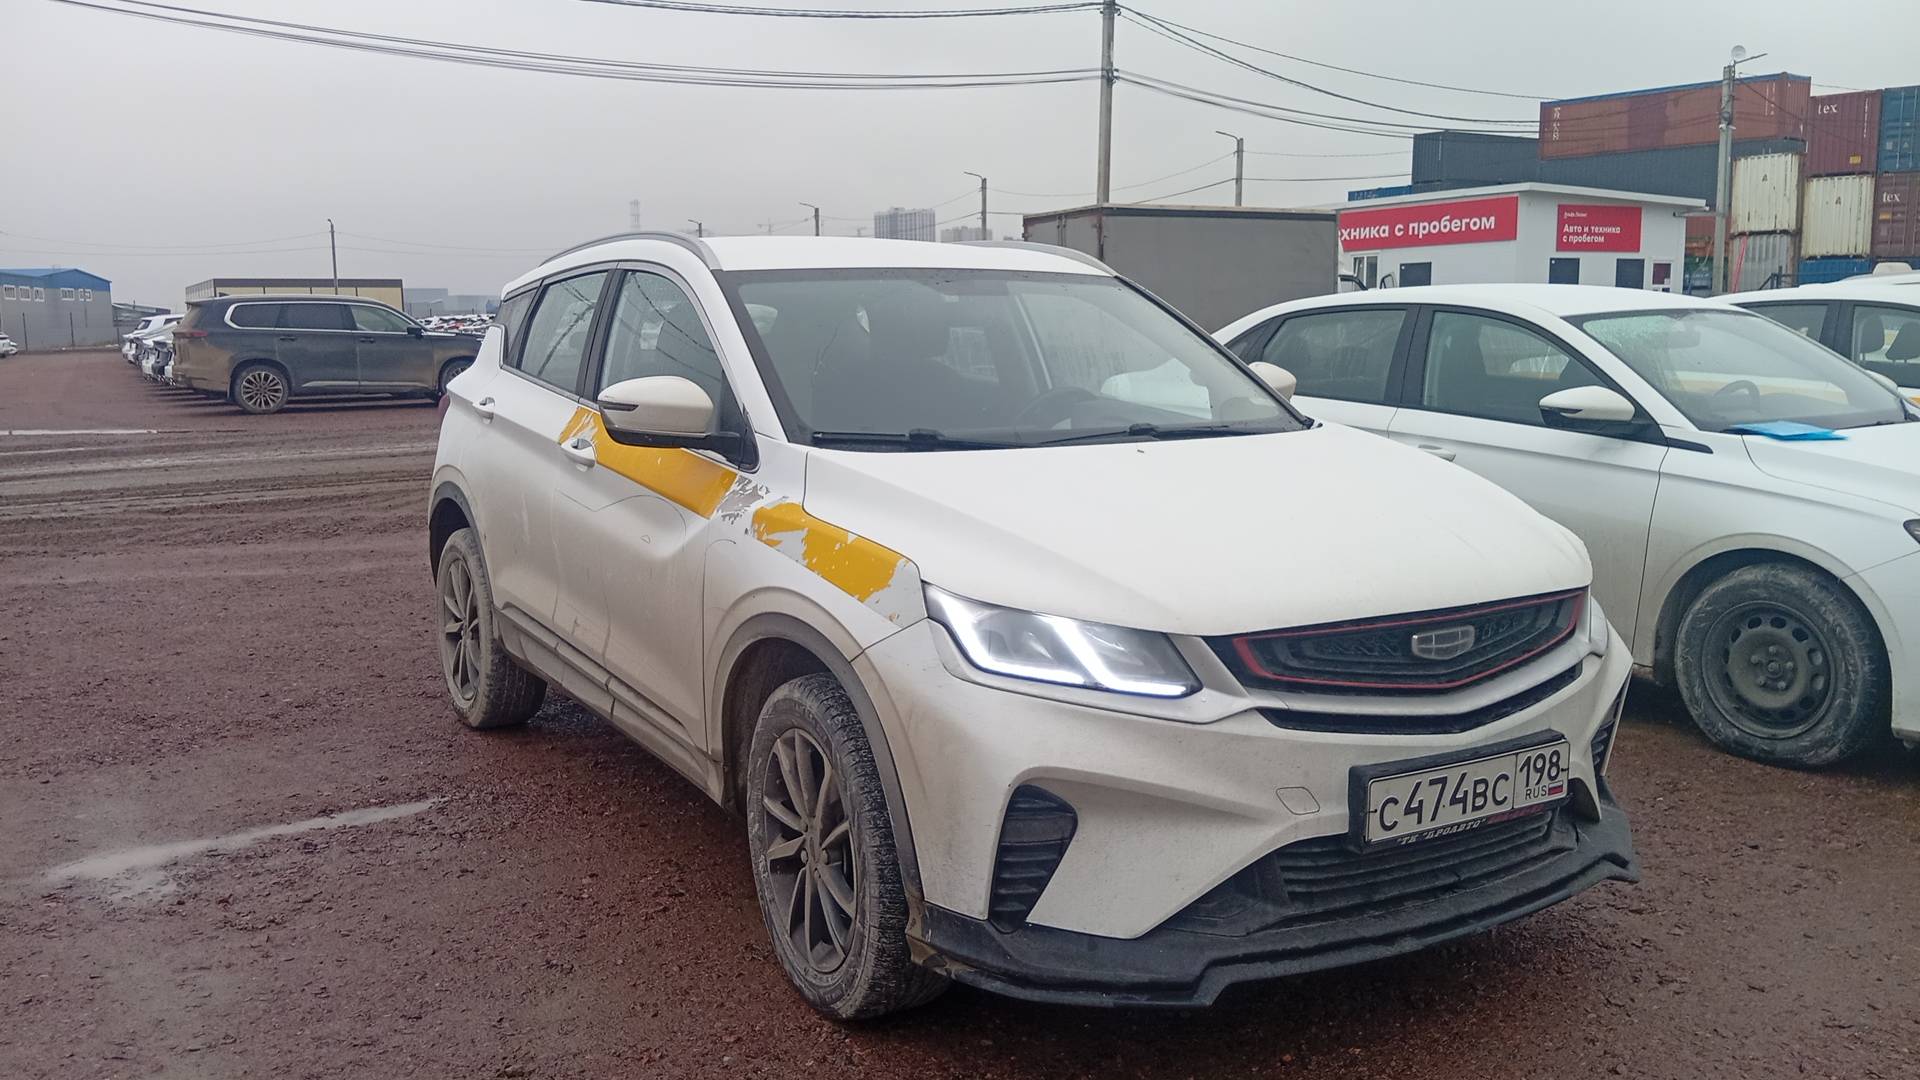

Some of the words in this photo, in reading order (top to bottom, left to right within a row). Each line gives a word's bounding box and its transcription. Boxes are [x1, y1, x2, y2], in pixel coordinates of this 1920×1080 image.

[1882, 191, 1901, 203] tex
[1338, 224, 1389, 241] хника
[1394, 223, 1405, 237] с
[1408, 214, 1496, 239] пробегом
[1563, 223, 1583, 233] Авто
[1583, 225, 1589, 233] и
[1590, 225, 1621, 234] техника
[1562, 235, 1568, 243] с
[1568, 234, 1605, 244] пробегом
[1379, 772, 1510, 832] С474ВС
[1518, 749, 1561, 788] 198
[1525, 784, 1548, 800] RUS
